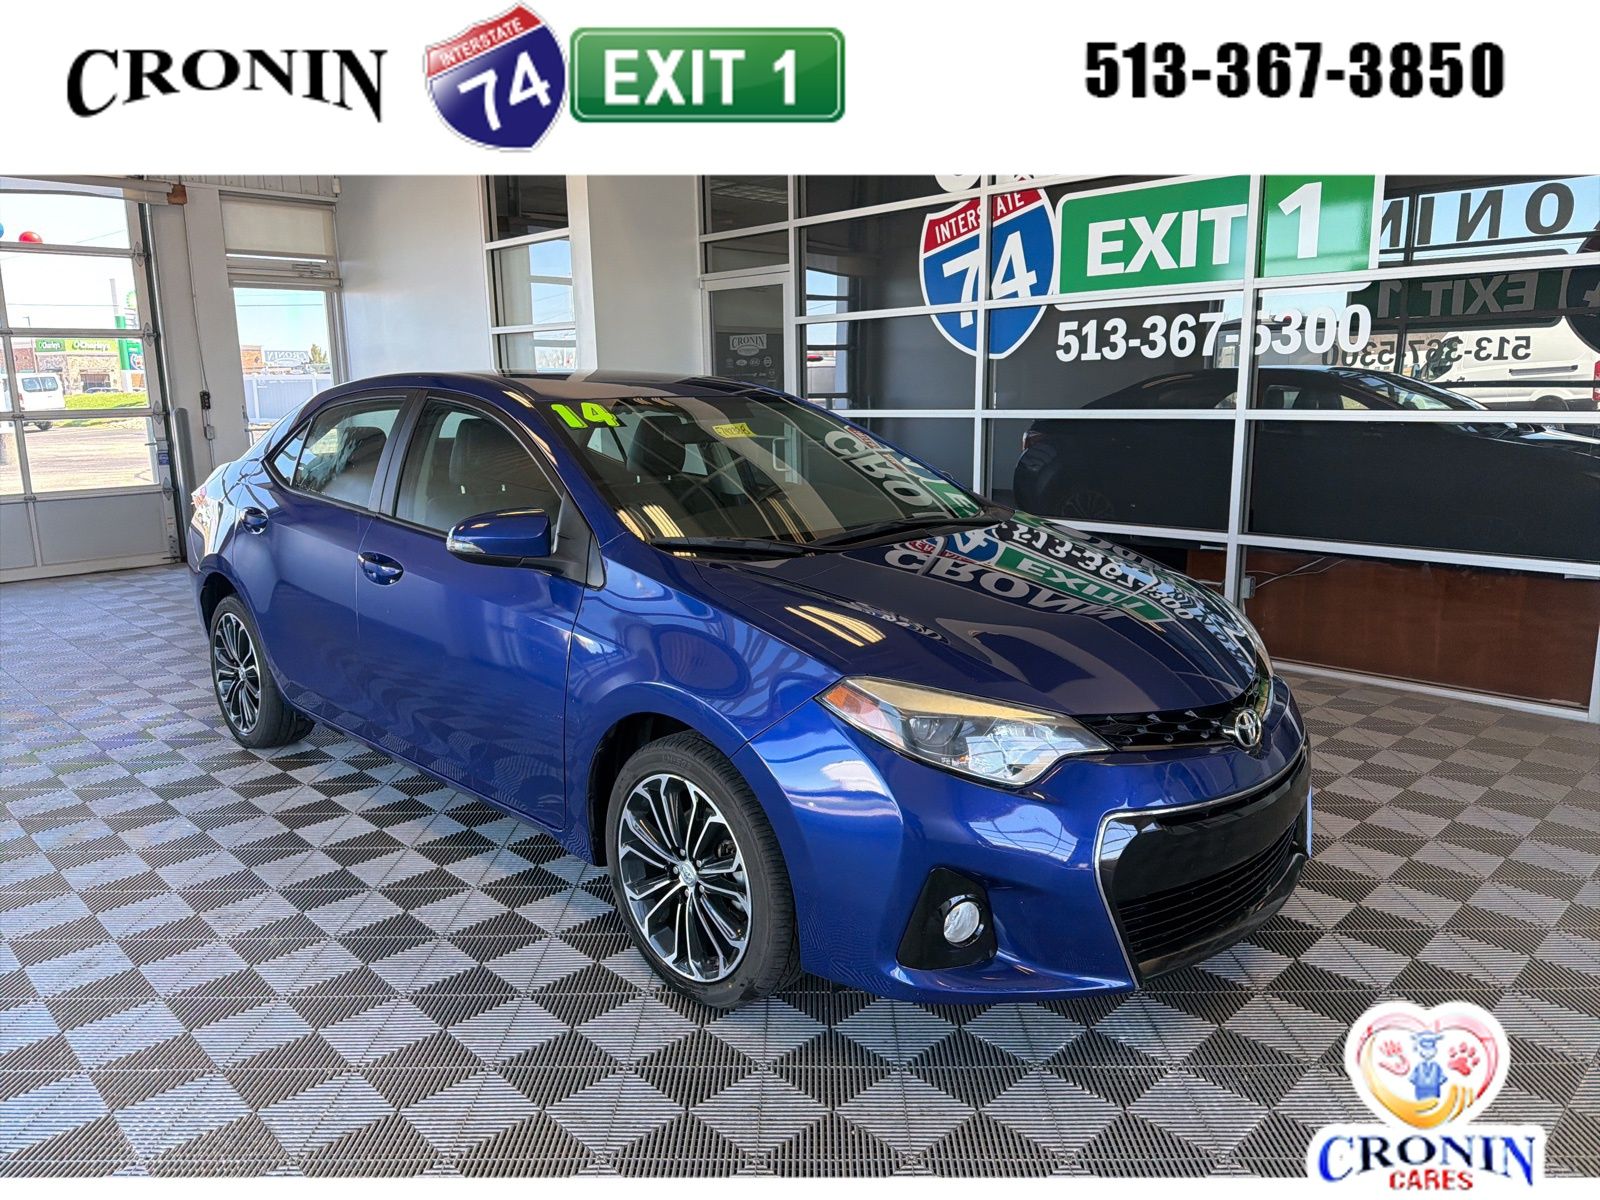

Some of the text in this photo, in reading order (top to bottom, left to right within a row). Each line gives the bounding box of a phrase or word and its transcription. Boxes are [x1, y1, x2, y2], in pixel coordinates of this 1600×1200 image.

[935, 191, 1025, 245] INTERATE
[1086, 181, 1323, 278] EXIT 1
[942, 230, 1038, 329] 74
[550, 401, 621, 429] 14
